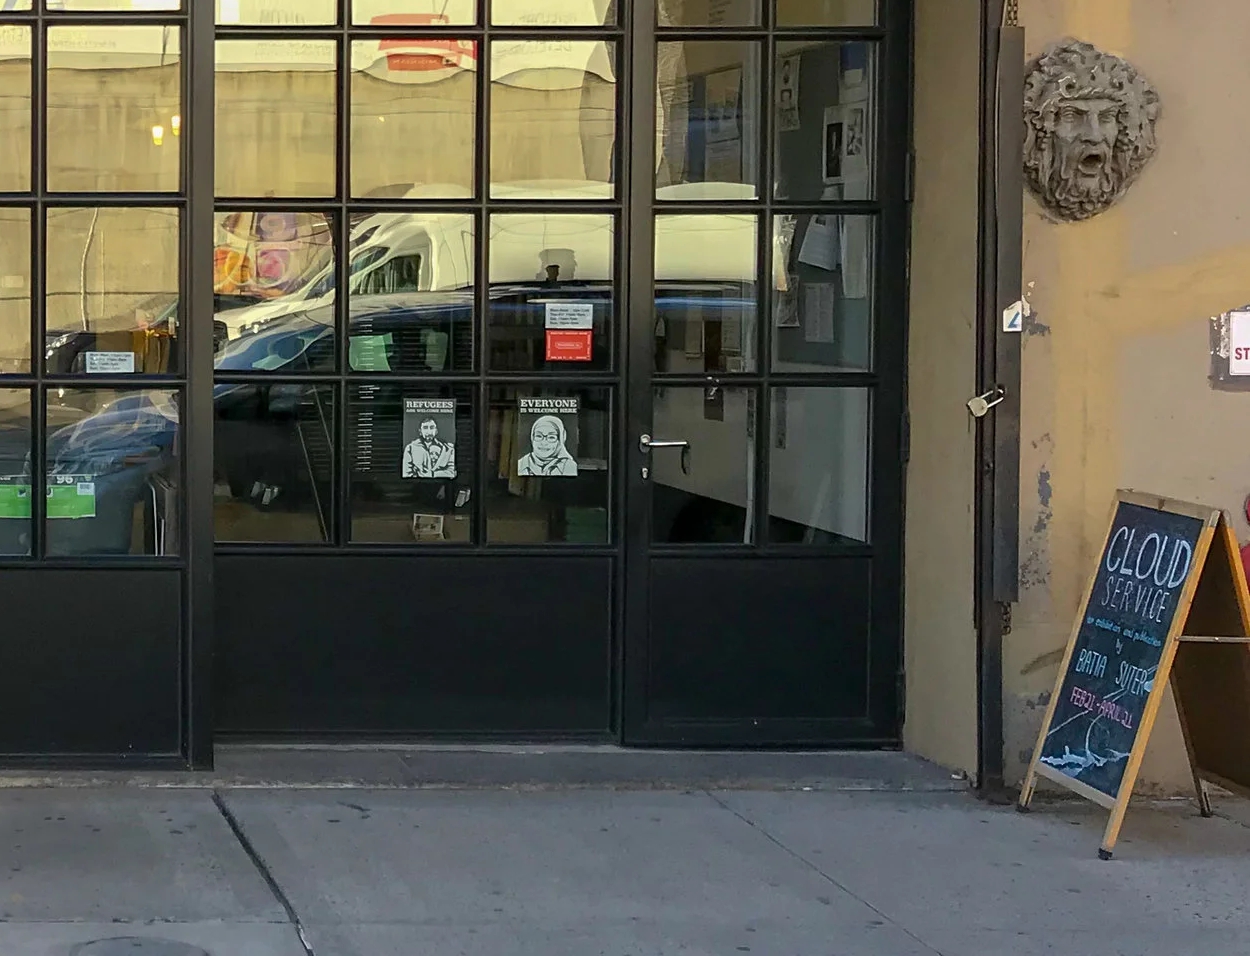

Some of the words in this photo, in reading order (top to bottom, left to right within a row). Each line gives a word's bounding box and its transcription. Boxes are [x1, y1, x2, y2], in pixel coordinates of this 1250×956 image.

[1235, 347, 1250, 360] ST
[406, 401, 454, 409] REFUGEES
[520, 399, 578, 408] EVERYONE
[1106, 526, 1192, 589] CLOUD
[1101, 575, 1170, 623] SERVICE
[1075, 648, 1108, 678] BATIA
[1115, 660, 1148, 696] SUTER
